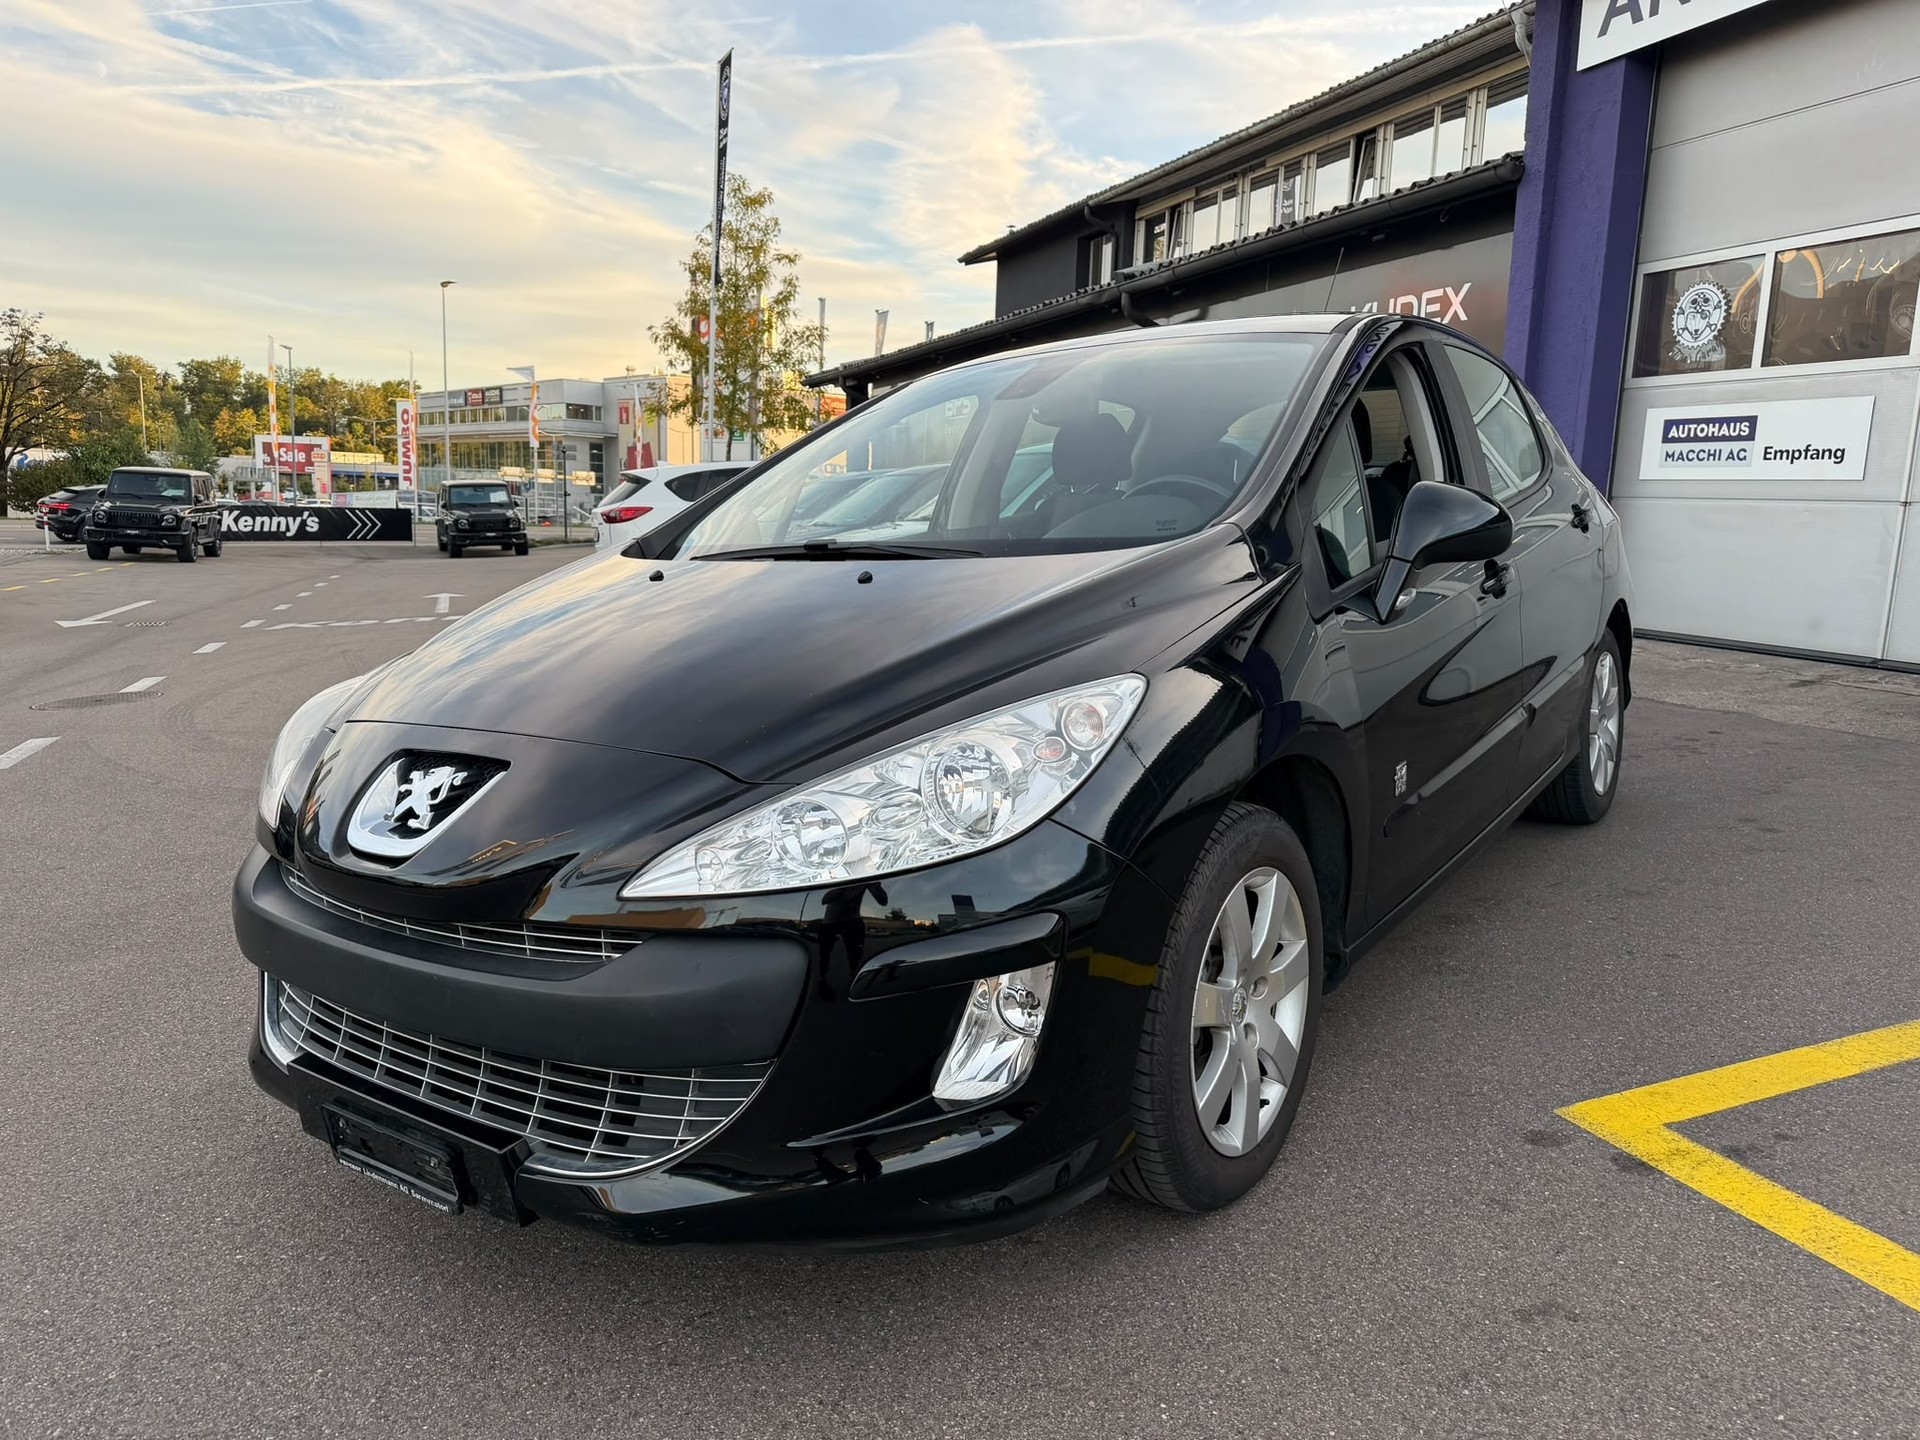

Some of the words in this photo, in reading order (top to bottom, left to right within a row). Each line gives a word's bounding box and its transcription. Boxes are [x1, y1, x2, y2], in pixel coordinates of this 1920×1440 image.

[1597, 0, 1691, 38] A
[1351, 282, 1472, 324] DEX
[1667, 421, 1750, 438] AUTOHAUS
[280, 447, 306, 462] Sale
[401, 408, 413, 487] JUMBO
[1664, 448, 1721, 462] MACCHI
[1725, 448, 1748, 462] AG
[1762, 444, 1846, 465] Empfang
[220, 510, 320, 537] Kenny's
